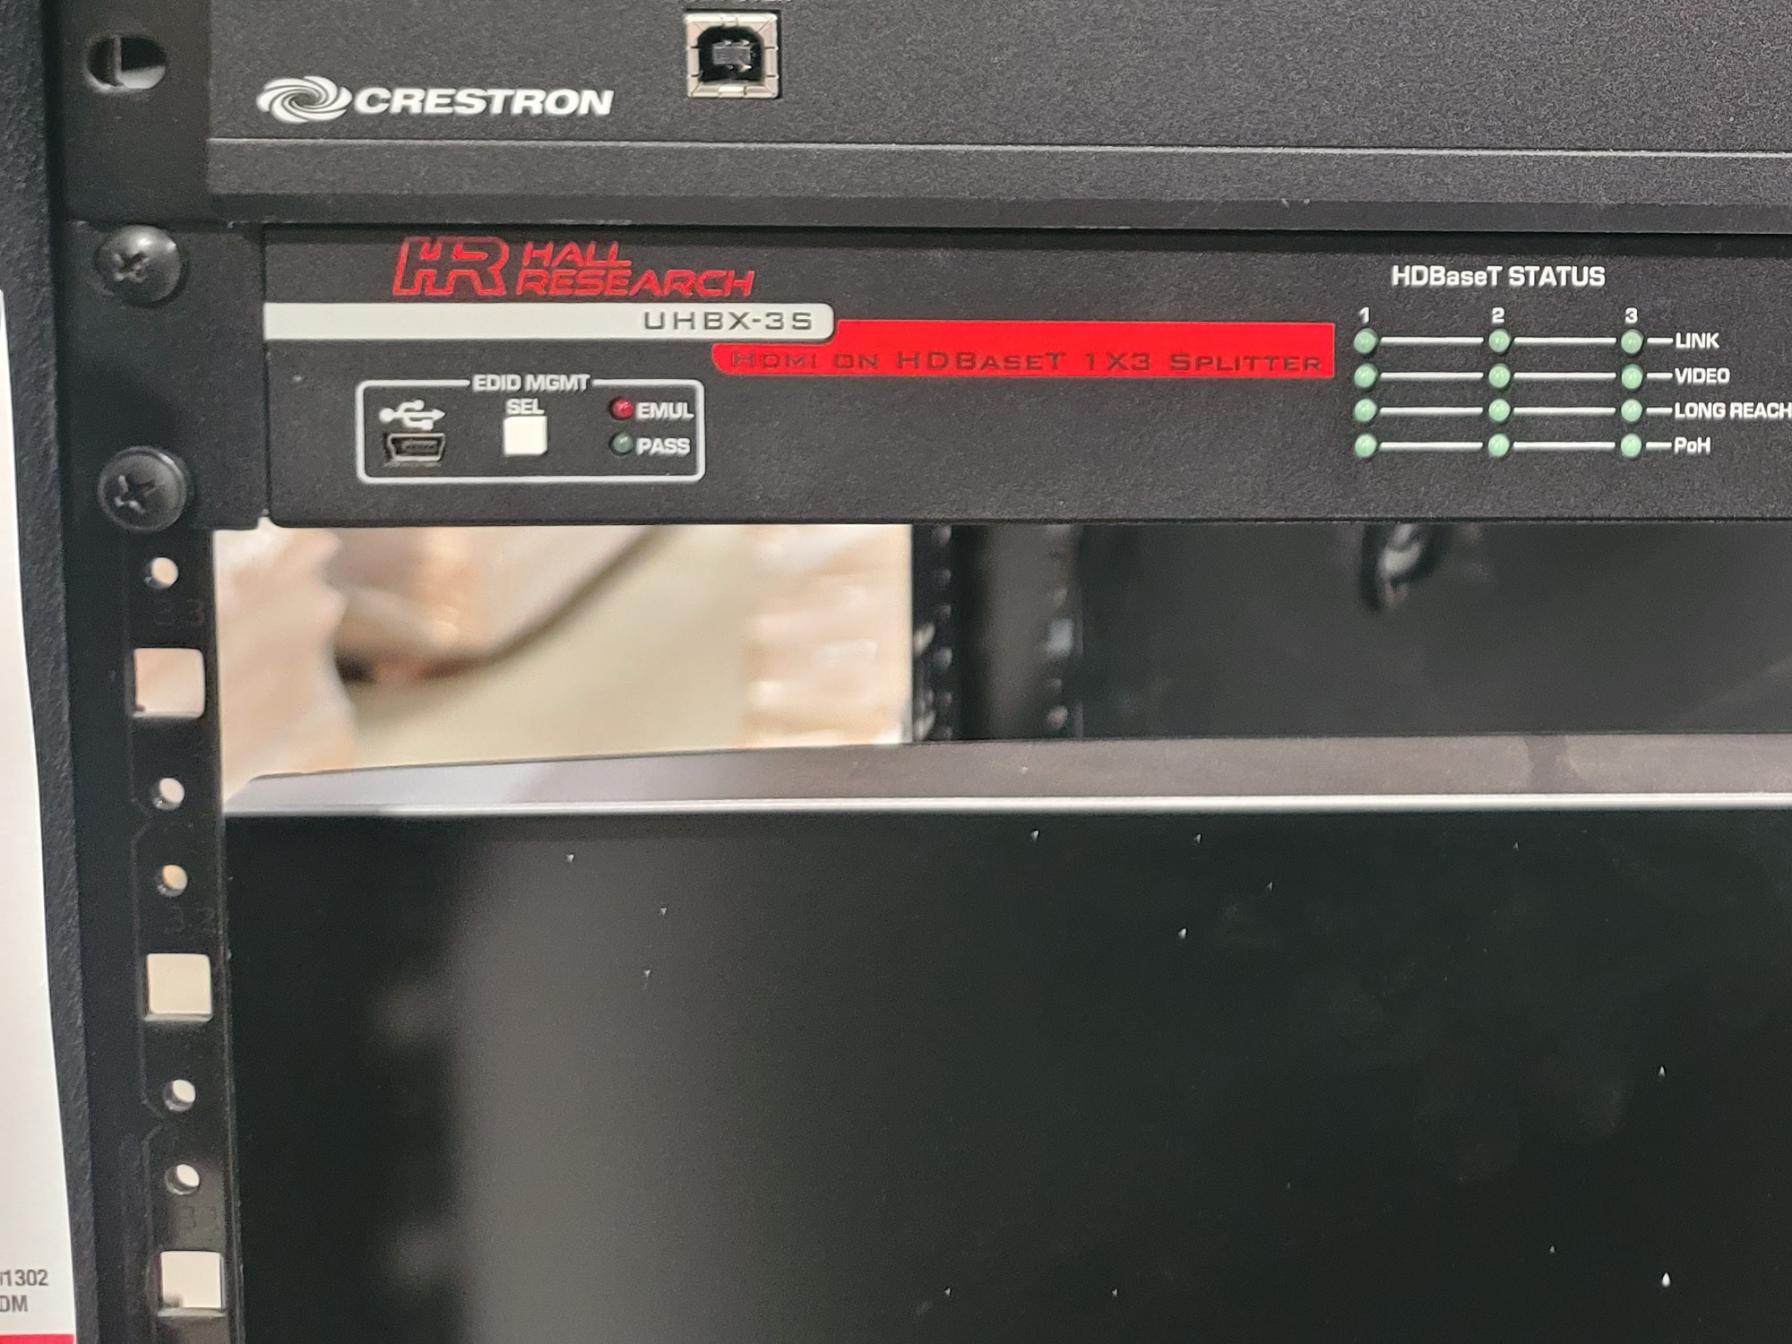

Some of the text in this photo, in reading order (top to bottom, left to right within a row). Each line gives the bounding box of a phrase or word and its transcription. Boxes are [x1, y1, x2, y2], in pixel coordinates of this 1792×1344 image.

[353, 87, 614, 116] CRESTRON
[521, 242, 632, 266] HALL
[516, 268, 755, 297] RESEARCH
[1391, 265, 1606, 287] HDBaseT STATUS
[644, 311, 812, 331] UHBX-3S
[1359, 306, 1638, 324] 1 2 3
[1674, 332, 1720, 349] LINK
[472, 373, 591, 392] EDID MGMT
[1674, 367, 1731, 384] VIDEO
[506, 398, 545, 415] SEL
[635, 402, 695, 420] EMUL
[1674, 402, 1792, 419] LONG REACH
[636, 437, 691, 455] PASS
[1674, 436, 1711, 454] PoH
